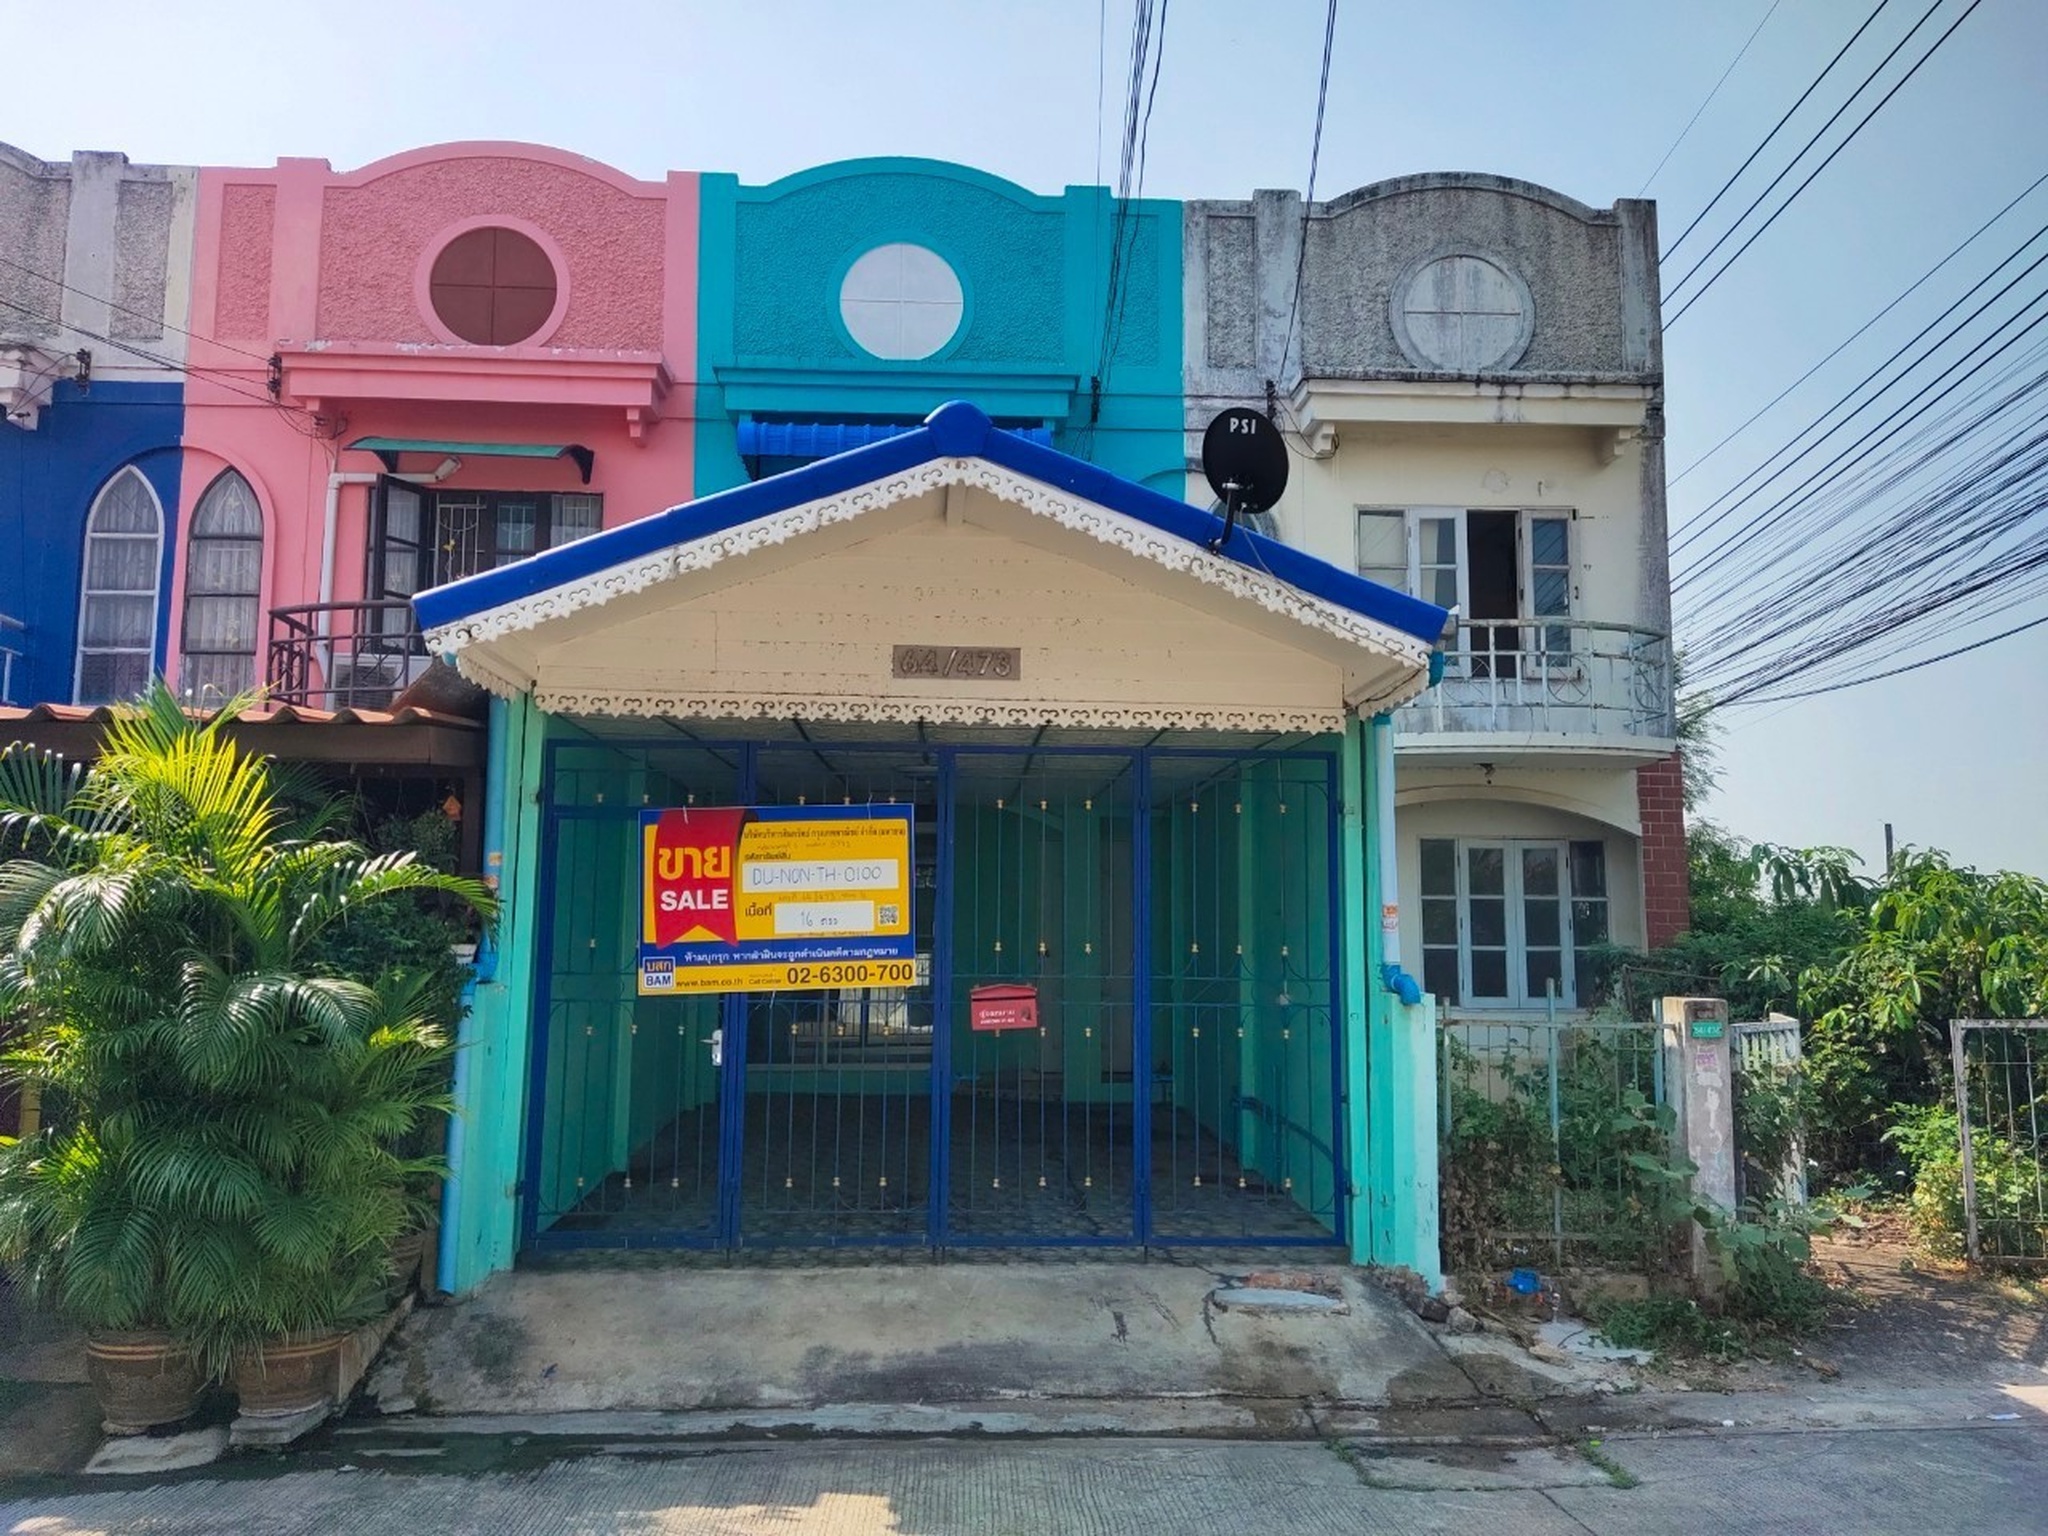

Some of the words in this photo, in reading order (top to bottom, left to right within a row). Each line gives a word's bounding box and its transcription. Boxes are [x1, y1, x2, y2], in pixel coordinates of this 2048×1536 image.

[1229, 417, 1257, 435] PSI
[900, 648, 1013, 678] 64/473
[658, 845, 731, 881] ขาย
[660, 889, 729, 911] SALE
[745, 902, 773, 917] เนื้อที่
[800, 910, 814, 928] 16
[646, 960, 672, 972] บสก
[786, 963, 914, 987] 02-6300-700
[646, 975, 672, 987] BAM
[675, 977, 744, 988] www.bam.co.th
